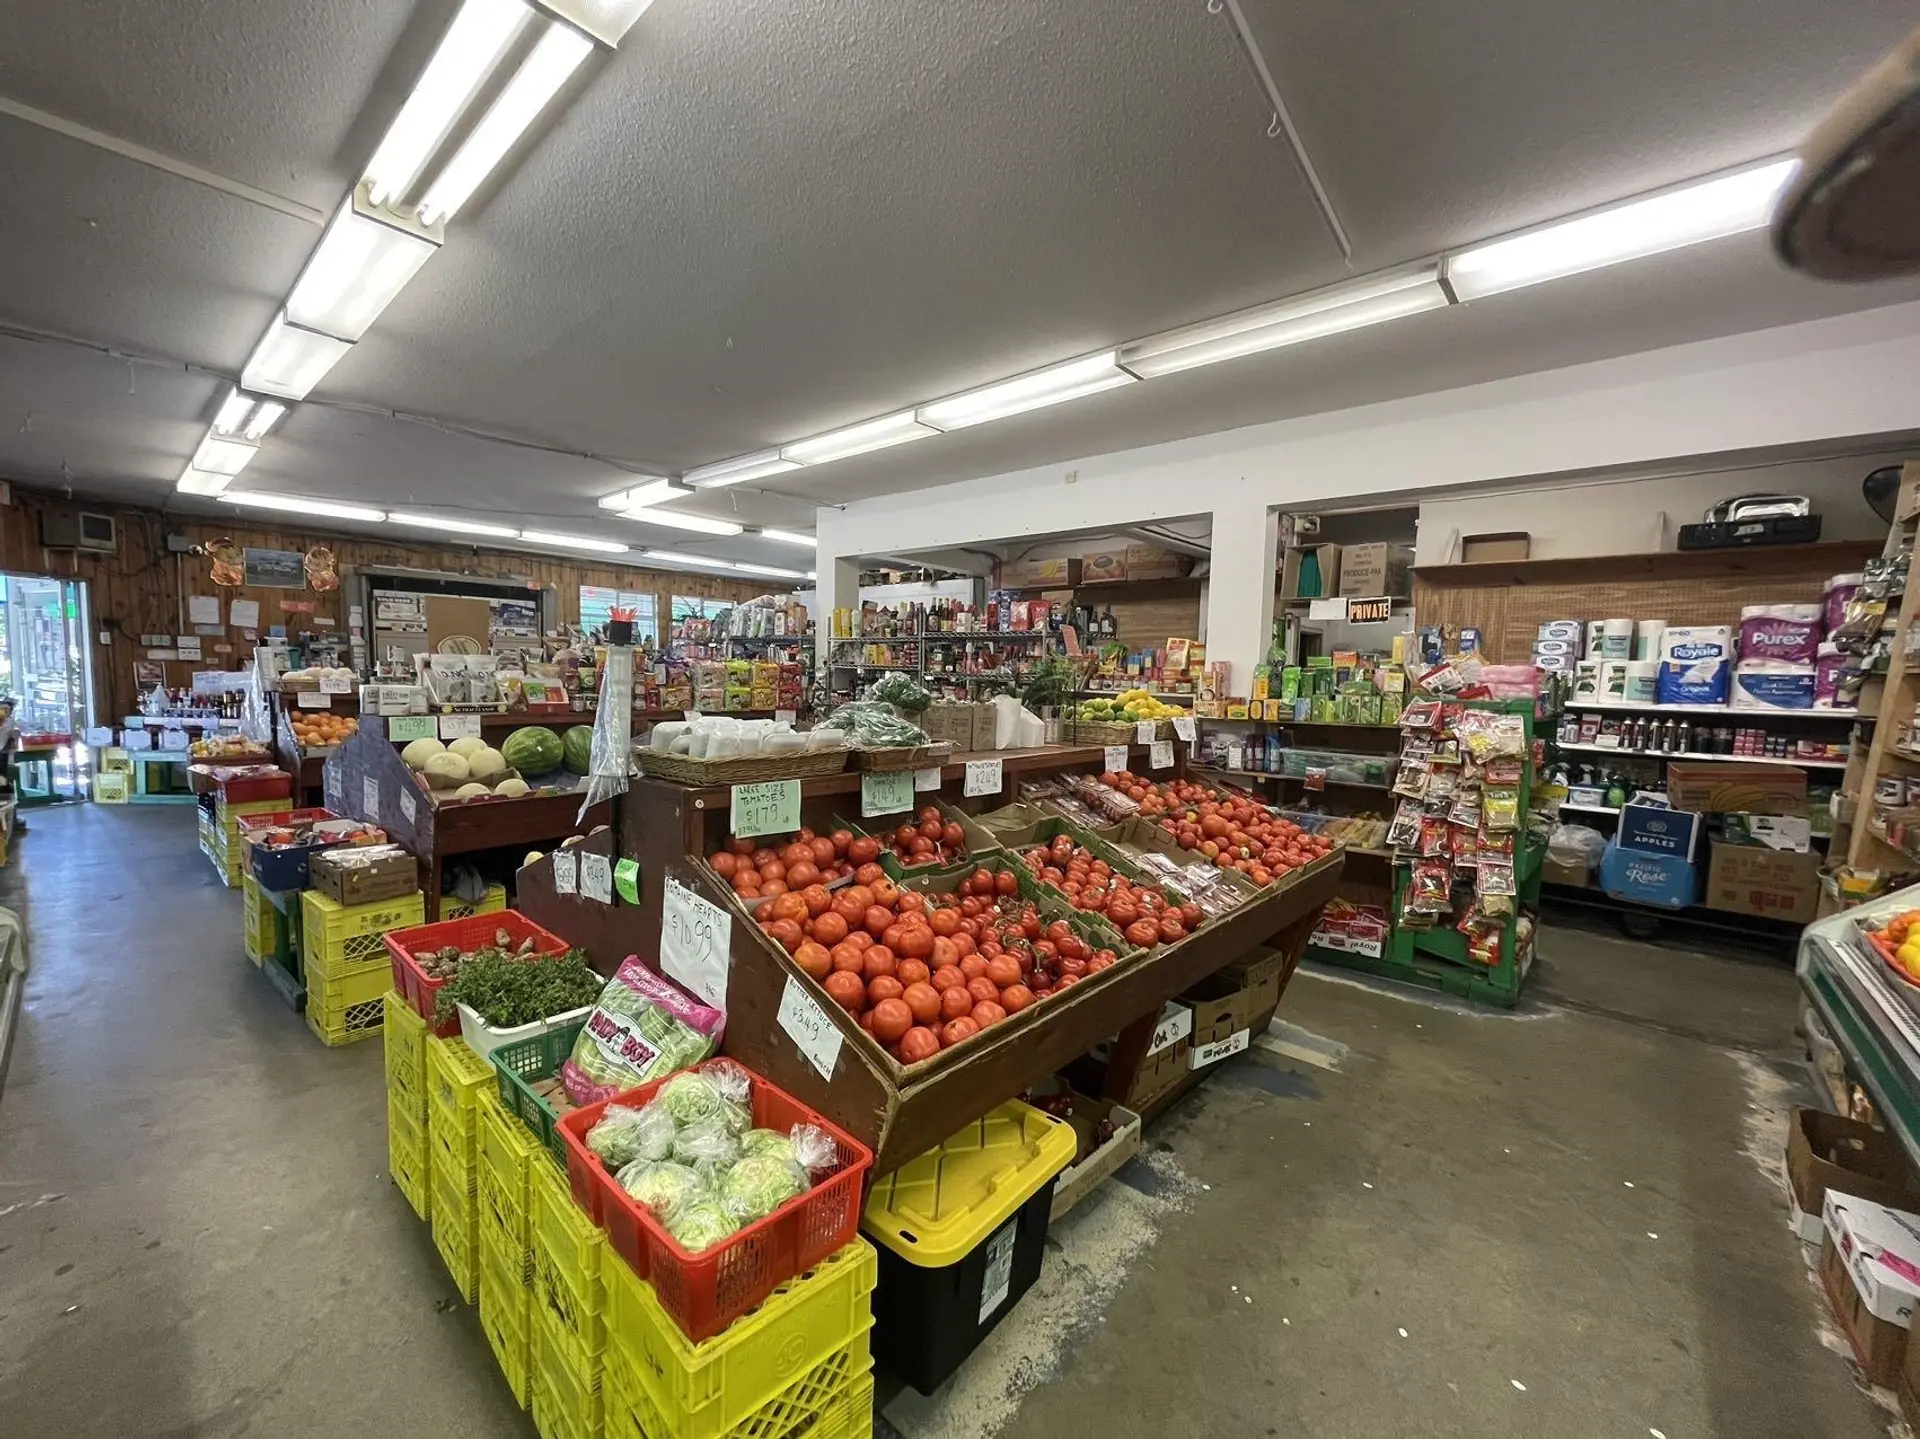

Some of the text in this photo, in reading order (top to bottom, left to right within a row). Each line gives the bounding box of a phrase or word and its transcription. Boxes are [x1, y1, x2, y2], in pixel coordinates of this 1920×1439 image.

[1350, 604, 1389, 620] PRIVATE
[1752, 632, 1808, 645] Purex
[1673, 646, 1720, 659] Royale
[765, 783, 785, 793] SIZE
[740, 790, 786, 806] TOMATOES
[1634, 836, 1676, 849] APPLES
[692, 902, 723, 928] HEARTS
[1350, 941, 1378, 952] Royal
[808, 1001, 833, 1032] LETTUCE
[587, 1009, 656, 1069] ANDY BOY
